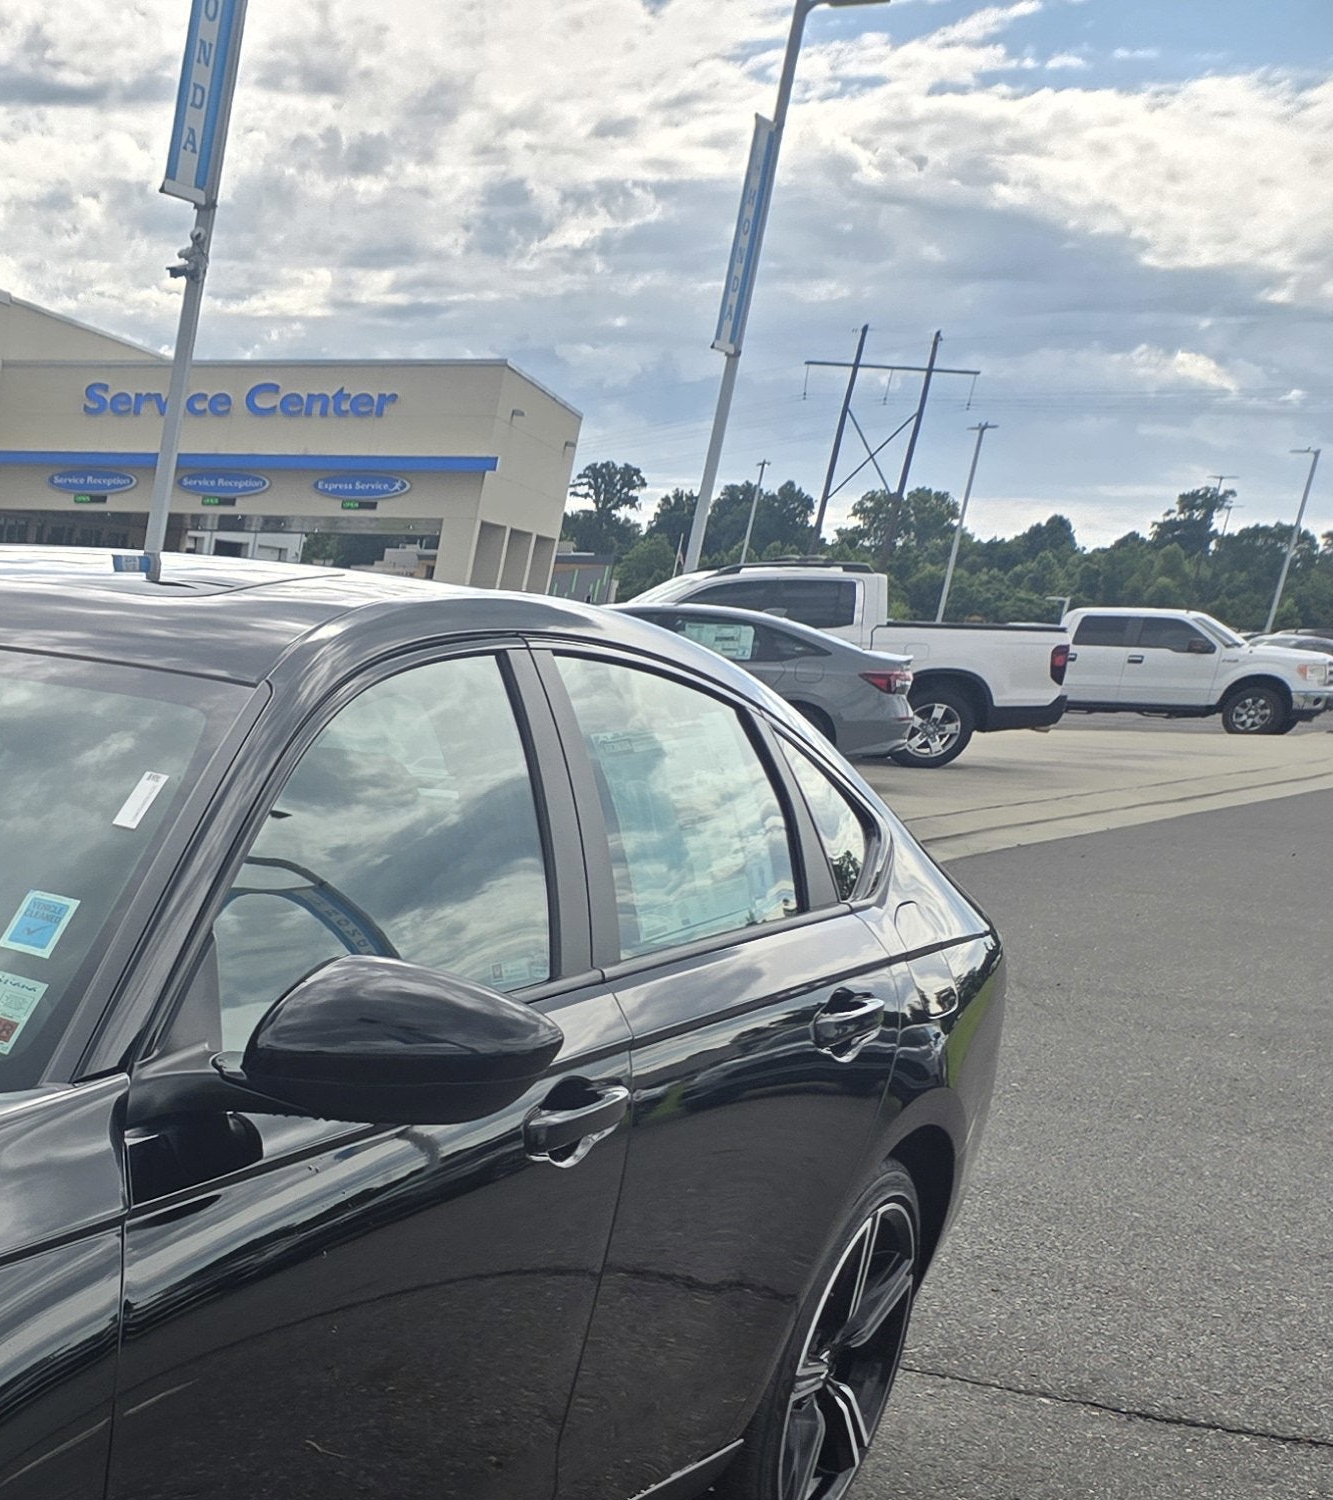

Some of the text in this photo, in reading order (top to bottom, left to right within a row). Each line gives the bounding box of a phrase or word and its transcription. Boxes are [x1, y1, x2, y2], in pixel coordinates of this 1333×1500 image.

[725, 188, 757, 321] HONDA
[83, 381, 399, 418] Servce Center
[53, 476, 131, 486] Service Reception
[182, 476, 263, 488] Service Reception
[317, 481, 389, 491] Express Service
